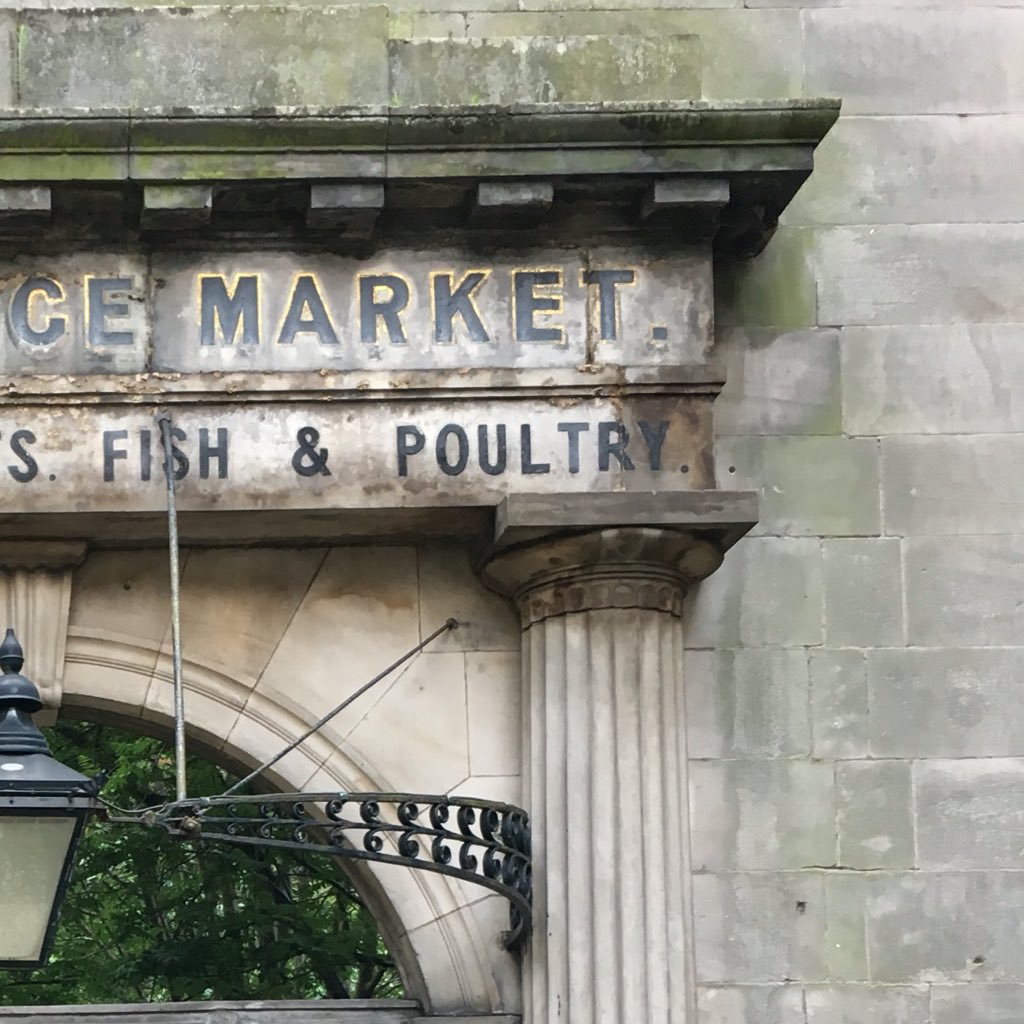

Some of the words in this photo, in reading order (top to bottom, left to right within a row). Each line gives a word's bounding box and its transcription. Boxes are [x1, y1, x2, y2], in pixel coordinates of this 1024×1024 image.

[196, 267, 670, 346] MARKET.
[102, 427, 228, 482] FISH
[291, 426, 332, 478] &
[396, 420, 690, 478] POULTRY.
